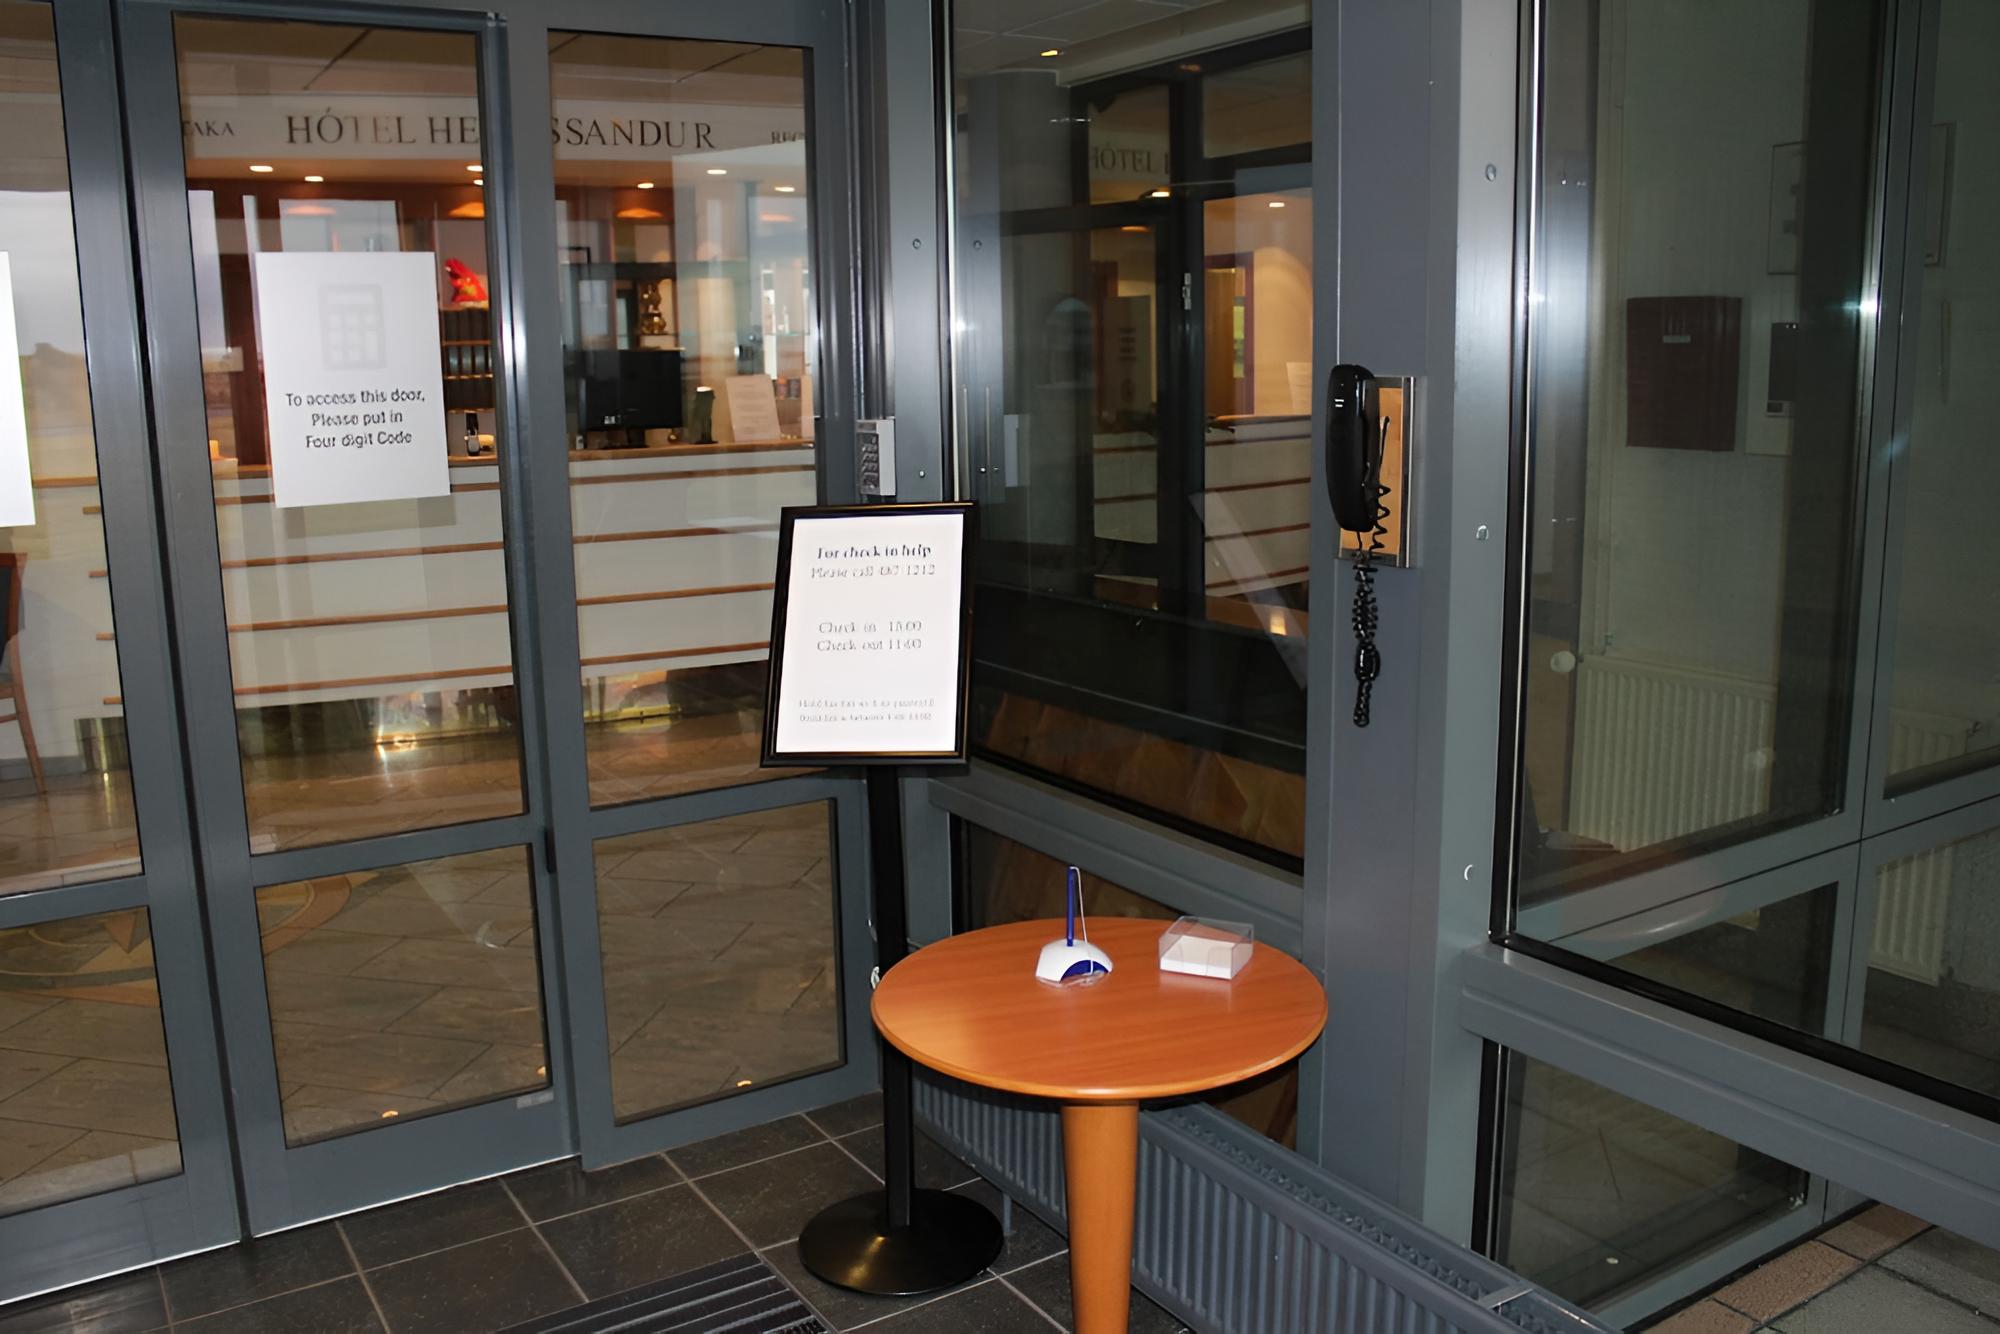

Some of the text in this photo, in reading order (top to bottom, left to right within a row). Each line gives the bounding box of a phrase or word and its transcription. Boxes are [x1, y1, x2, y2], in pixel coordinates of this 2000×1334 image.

[286, 106, 417, 145] HÓTEL
[285, 393, 302, 407] To
[306, 393, 357, 406] access
[360, 389, 387, 403] this
[311, 410, 403, 427] Please put in
[306, 431, 413, 449] Four digit Code
